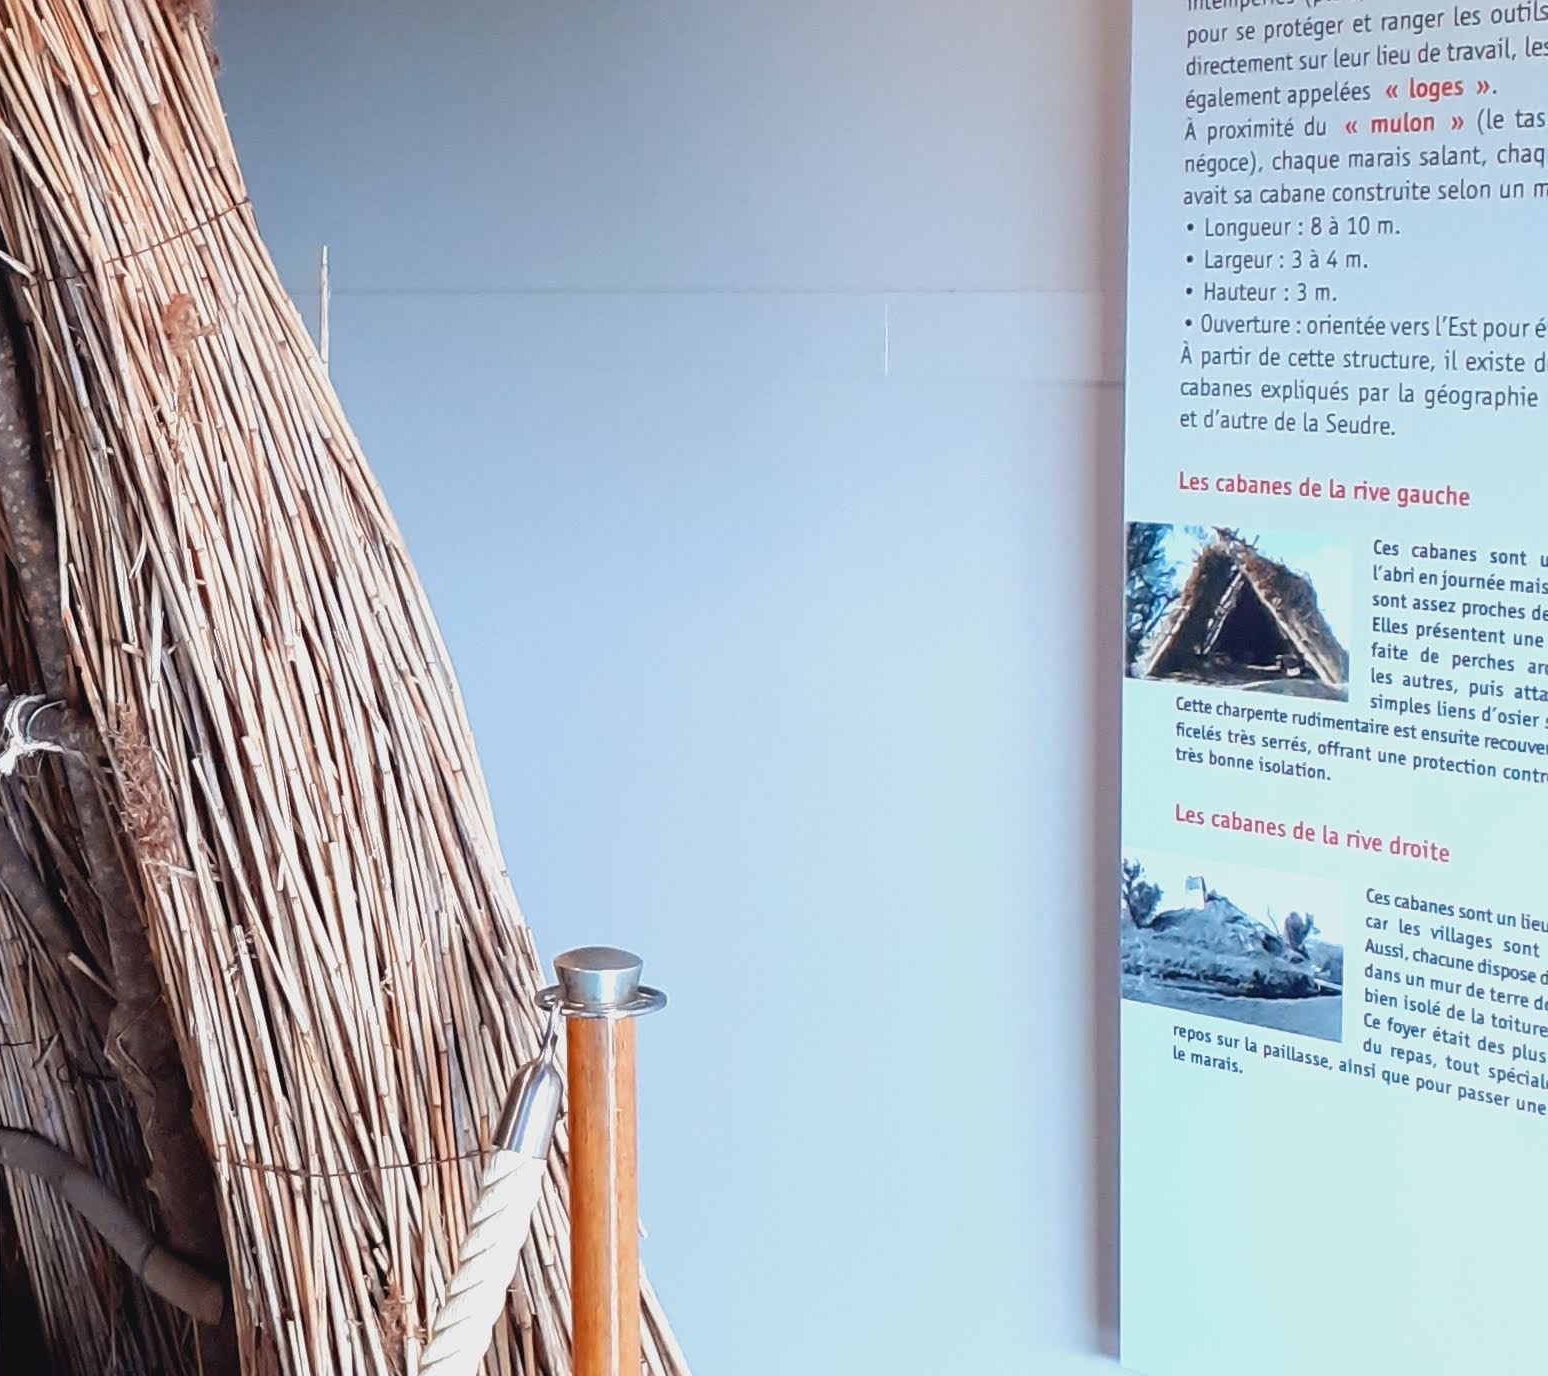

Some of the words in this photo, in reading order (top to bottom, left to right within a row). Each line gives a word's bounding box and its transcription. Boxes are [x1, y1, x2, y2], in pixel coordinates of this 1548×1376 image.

[1187, 27, 1229, 49] pour
[1236, 25, 1256, 41] se
[1264, 16, 1344, 44] protéger
[1352, 14, 1373, 34] et
[1381, 12, 1445, 35] ranger
[1454, 5, 1481, 27] les
[1490, 0, 1548, 25] outils
[1186, 54, 1294, 76] directement
[1299, 53, 1328, 71] sur
[1333, 47, 1371, 68] leur
[1376, 44, 1411, 66] lieu
[1417, 41, 1441, 64] de
[1446, 37, 1517, 62] travail,
[1185, 86, 1282, 114] également
[1287, 81, 1371, 109] appelées
[1409, 77, 1464, 103] loges
[1184, 117, 1197, 141] À
[1207, 117, 1295, 145] proximité
[1304, 115, 1327, 137] du
[1371, 111, 1435, 134] mulon
[1477, 108, 1505, 135] (le
[1514, 109, 1546, 129] tas
[1185, 151, 1264, 178] négoce),
[1272, 149, 1340, 175] chaque
[1348, 146, 1411, 168] marais
[1418, 144, 1487, 167] salant,
[1183, 184, 1229, 206] avait
[1233, 189, 1253, 205] sa
[1259, 183, 1326, 204] cabane
[1332, 179, 1431, 203] construite
[1437, 178, 1491, 200] selon
[1499, 182, 1524, 199] un
[1205, 217, 1292, 242] Longueur
[1310, 216, 1322, 236] 8
[1328, 215, 1339, 236] à
[1347, 215, 1370, 236] 10
[1377, 220, 1401, 235] m.
[1205, 250, 1274, 275] Largeur
[1291, 249, 1302, 269] 3
[1309, 248, 1320, 269] à
[1326, 250, 1338, 268] 4
[1345, 253, 1368, 269] m.
[1204, 282, 1277, 302] Hauteur
[1297, 282, 1307, 302] 3
[1315, 287, 1337, 302] m.
[1201, 313, 1291, 334] Ouverture
[1306, 314, 1386, 336] orientée
[1390, 320, 1430, 337] vers
[1483, 322, 1531, 343] pour
[1180, 340, 1193, 364] À
[1201, 345, 1252, 369] partir
[1258, 346, 1281, 367] de
[1288, 349, 1335, 368] cette
[1343, 350, 1436, 373] structure,
[1443, 349, 1458, 371] il
[1465, 350, 1526, 373] existe
[1180, 377, 1253, 398] cabanes
[1261, 379, 1349, 405] expliqués
[1358, 386, 1390, 407] par
[1398, 382, 1415, 403] la
[1424, 383, 1539, 411] géographie
[1179, 410, 1198, 428] et
[1274, 411, 1296, 432] de
[1303, 411, 1318, 433] la
[1325, 413, 1396, 436] Seudre.
[1179, 471, 1209, 492] Les
[1215, 473, 1292, 496] cabanes
[1298, 477, 1322, 498] de
[1329, 478, 1346, 499] la
[1353, 480, 1391, 502] rive
[1397, 485, 1471, 508] gauche
[1373, 539, 1399, 557] Ces
[1411, 542, 1477, 562] cabanes
[1489, 550, 1527, 566] sont
[1418, 572, 1438, 586] en
[1439, 569, 1506, 591] journée
[1372, 616, 1409, 635] Elles
[1415, 622, 1506, 645] présentent
[1513, 633, 1544, 648] une
[1175, 696, 1213, 715] Cette
[1215, 701, 1289, 724] charpente
[1292, 711, 1390, 736] rudimentaire
[1393, 724, 1418, 740] est
[1420, 728, 1480, 747] ensuite
[1175, 721, 1222, 742] ficelés
[1227, 729, 1256, 746] très
[1261, 735, 1312, 755] serrés,
[1317, 740, 1372, 761] offrant
[1377, 751, 1407, 766] une
[1412, 755, 1497, 777] protection
[1175, 746, 1204, 764] très
[1209, 749, 1254, 771] bonne
[1258, 756, 1331, 781] isolation.
[1175, 803, 1205, 825] Les
[1211, 811, 1287, 838] cabanes
[1292, 821, 1316, 842] de
[1322, 824, 1339, 846] la
[1346, 829, 1383, 852] rive
[1389, 835, 1450, 863] droite
[1366, 887, 1391, 906] Ces
[1394, 894, 1455, 917] cabanes
[1458, 906, 1493, 924] sont
[1496, 913, 1517, 928] un
[1173, 1045, 1186, 1062] le
[1190, 1052, 1244, 1074] marais.
[1173, 1025, 1212, 1044] repos
[1217, 1034, 1241, 1049] sur
[1244, 1036, 1258, 1054] la
[1263, 1043, 1334, 1071] paillasse,
[1338, 1058, 1376, 1079] ainsi
[1381, 1069, 1410, 1086] que
[1416, 1077, 1452, 1095] pour
[1457, 1086, 1511, 1107] passer
[1516, 1098, 1547, 1116] une
